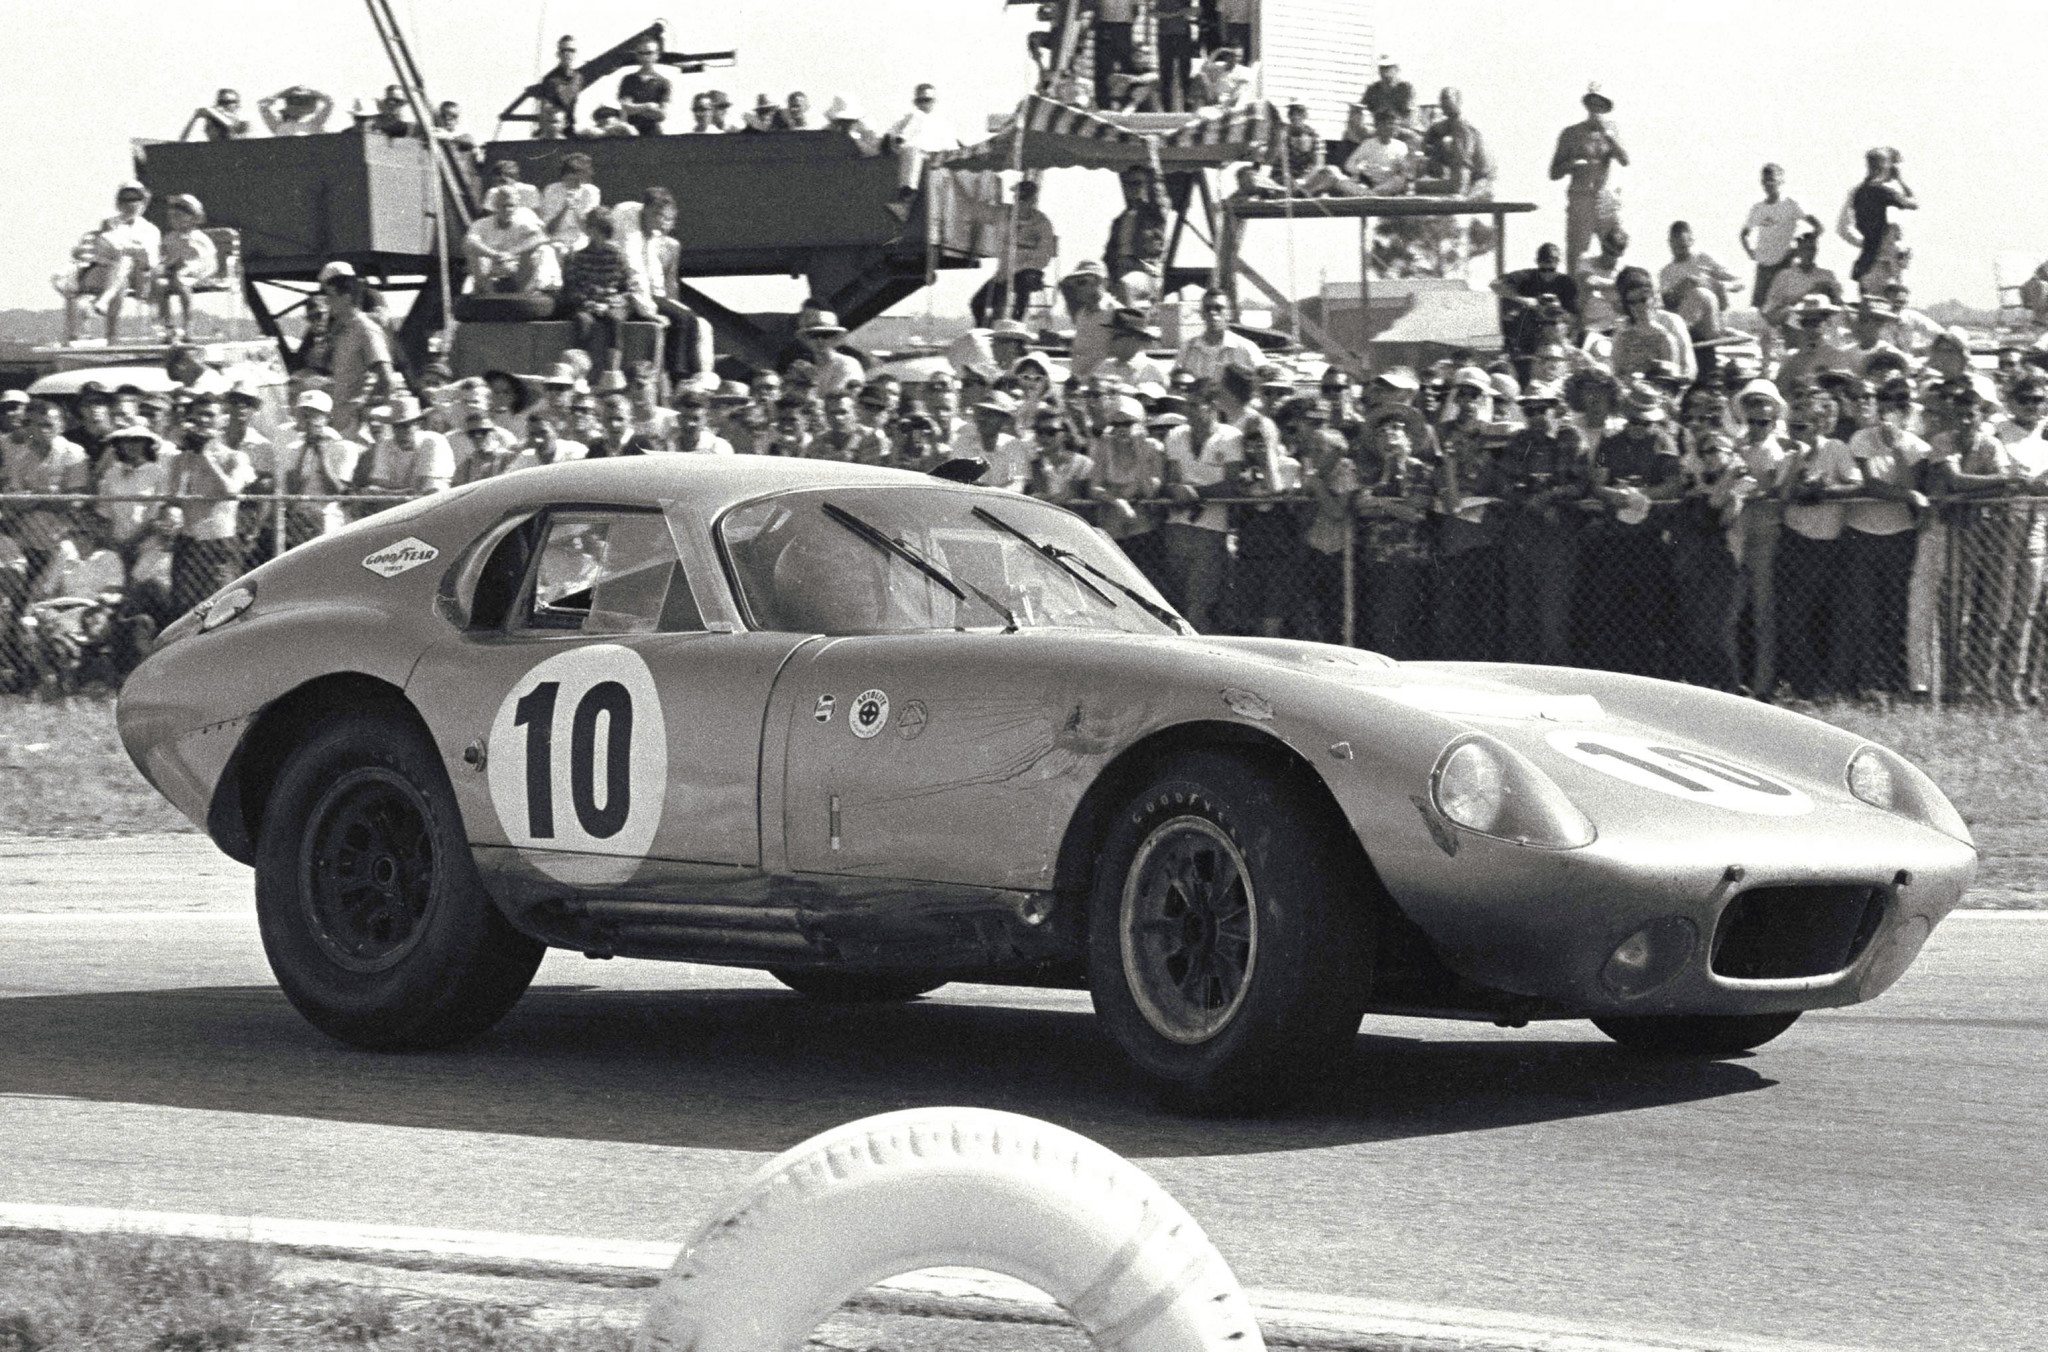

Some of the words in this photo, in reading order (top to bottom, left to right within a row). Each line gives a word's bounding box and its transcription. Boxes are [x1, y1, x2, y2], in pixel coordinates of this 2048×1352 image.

[365, 547, 435, 565] GOODYEAR
[514, 681, 633, 839] 10
[1575, 742, 1792, 796] 10
